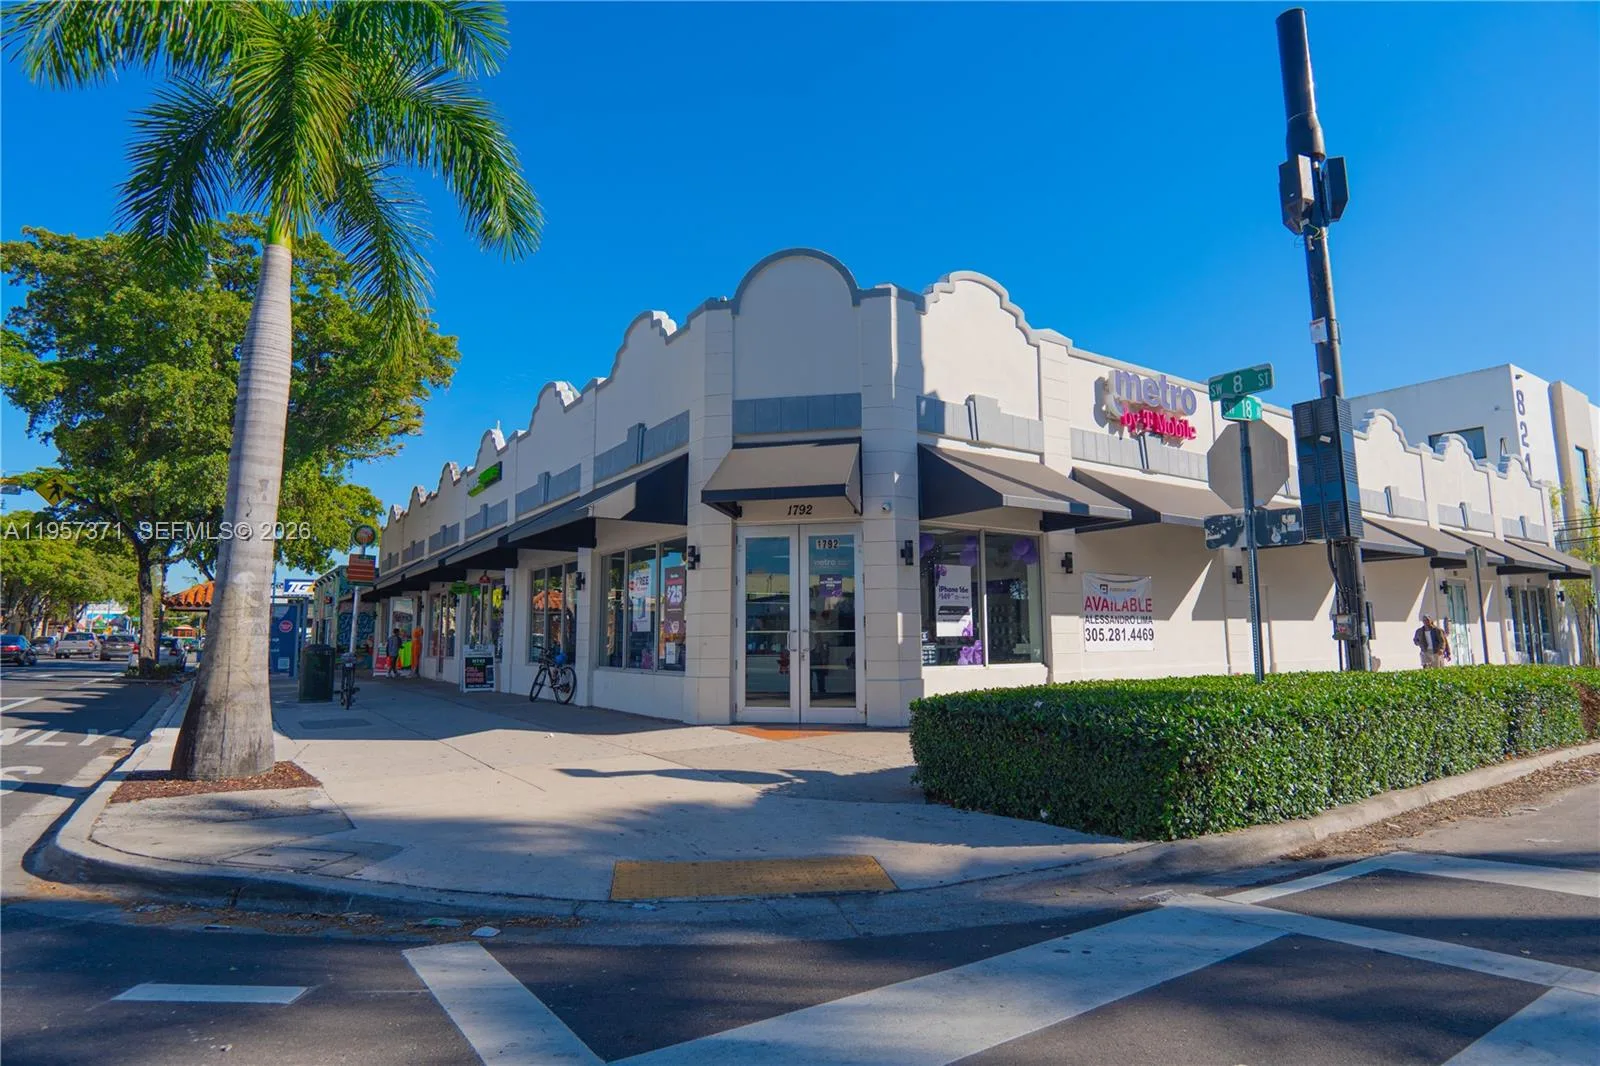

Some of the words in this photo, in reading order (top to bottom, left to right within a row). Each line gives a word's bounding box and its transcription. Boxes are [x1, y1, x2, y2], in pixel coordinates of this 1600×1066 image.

[1210, 383, 1223, 397] SW
[1233, 375, 1243, 393] 8
[1257, 372, 1269, 387] ST
[1113, 369, 1197, 416] metro
[1242, 400, 1253, 419] 18
[787, 504, 813, 516] 1792
[817, 539, 839, 549] 1792
[1084, 596, 1153, 613] AVAILABLE
[1085, 614, 1135, 625] ALESSANDRO
[1136, 615, 1153, 625] LIMA
[1085, 628, 1155, 642] 305.281.4469
